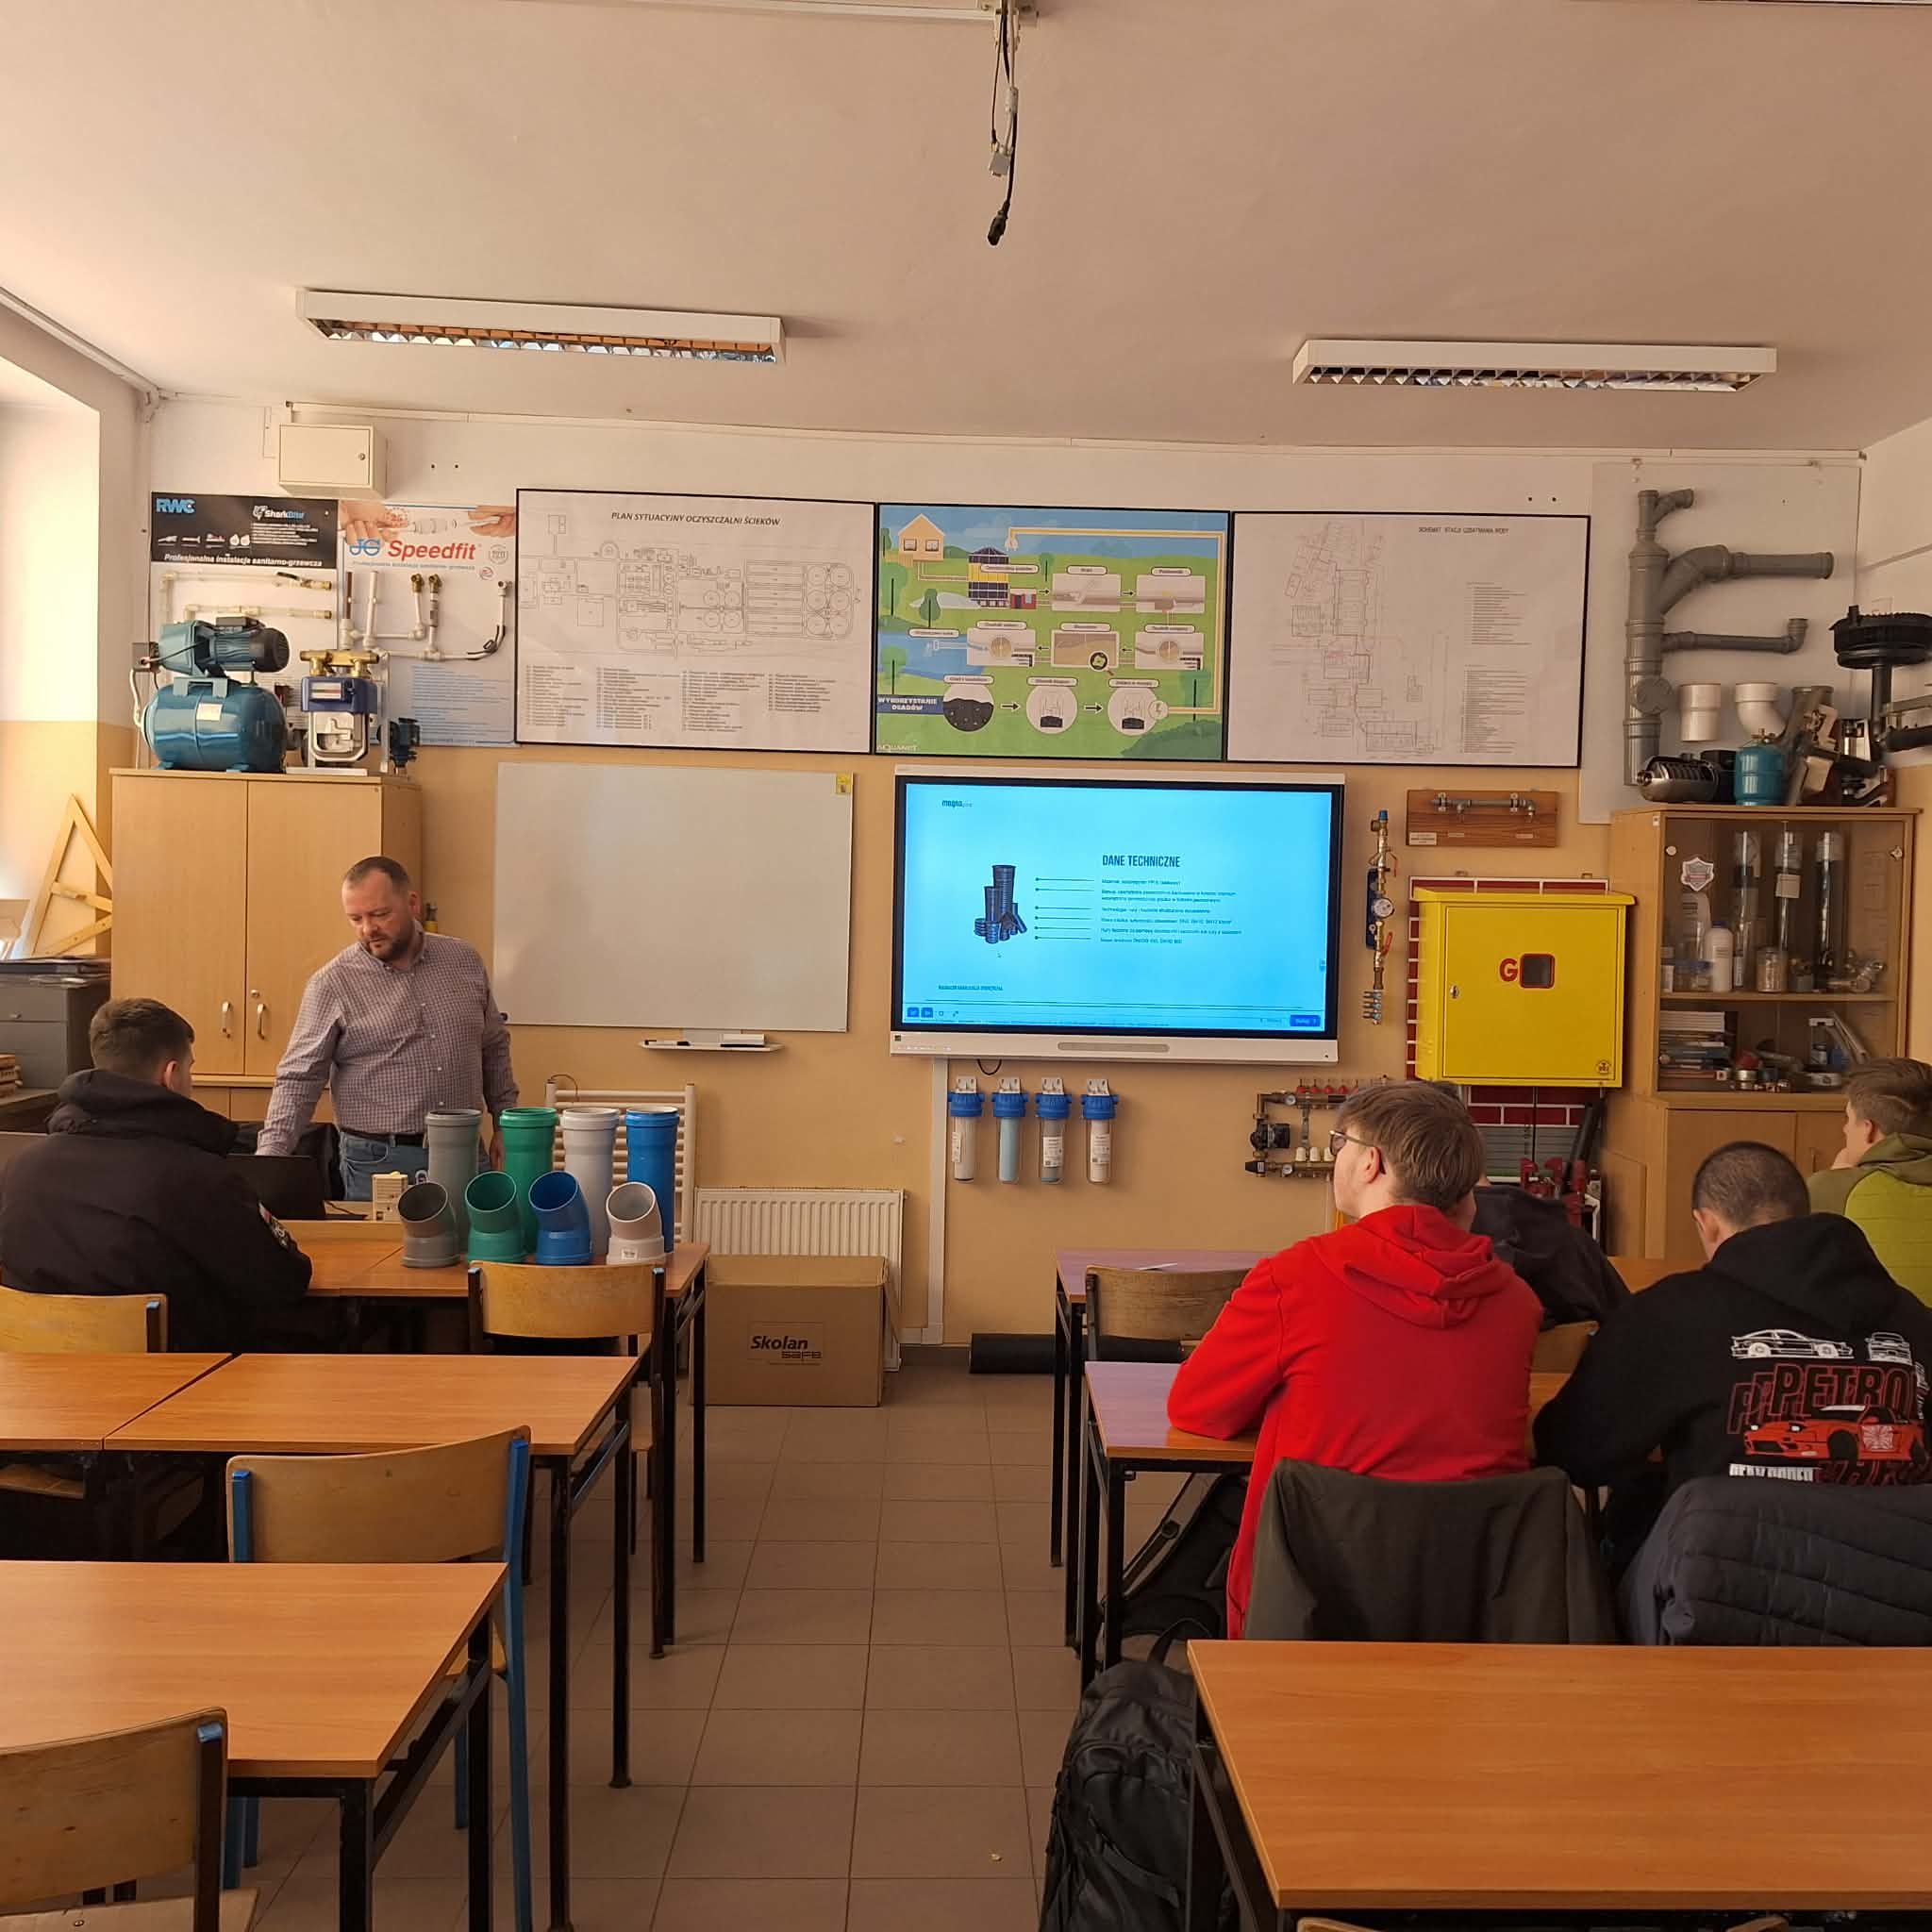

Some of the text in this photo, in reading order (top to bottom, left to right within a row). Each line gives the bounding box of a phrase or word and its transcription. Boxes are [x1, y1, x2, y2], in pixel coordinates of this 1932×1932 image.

[156, 498, 196, 514] RWC
[634, 513, 685, 522] SYTUACYJNY
[686, 515, 742, 525] OCZYSZCZALNI
[743, 515, 781, 525] ŚCIEKÓW
[388, 540, 476, 561] Speedfit
[164, 553, 323, 568] Profesjonalna instalacja sanitarno-grzewcza
[1102, 854, 1181, 868] DANE TECHNICZNE
[1499, 957, 1519, 983] G
[750, 1335, 808, 1350] Skolan
